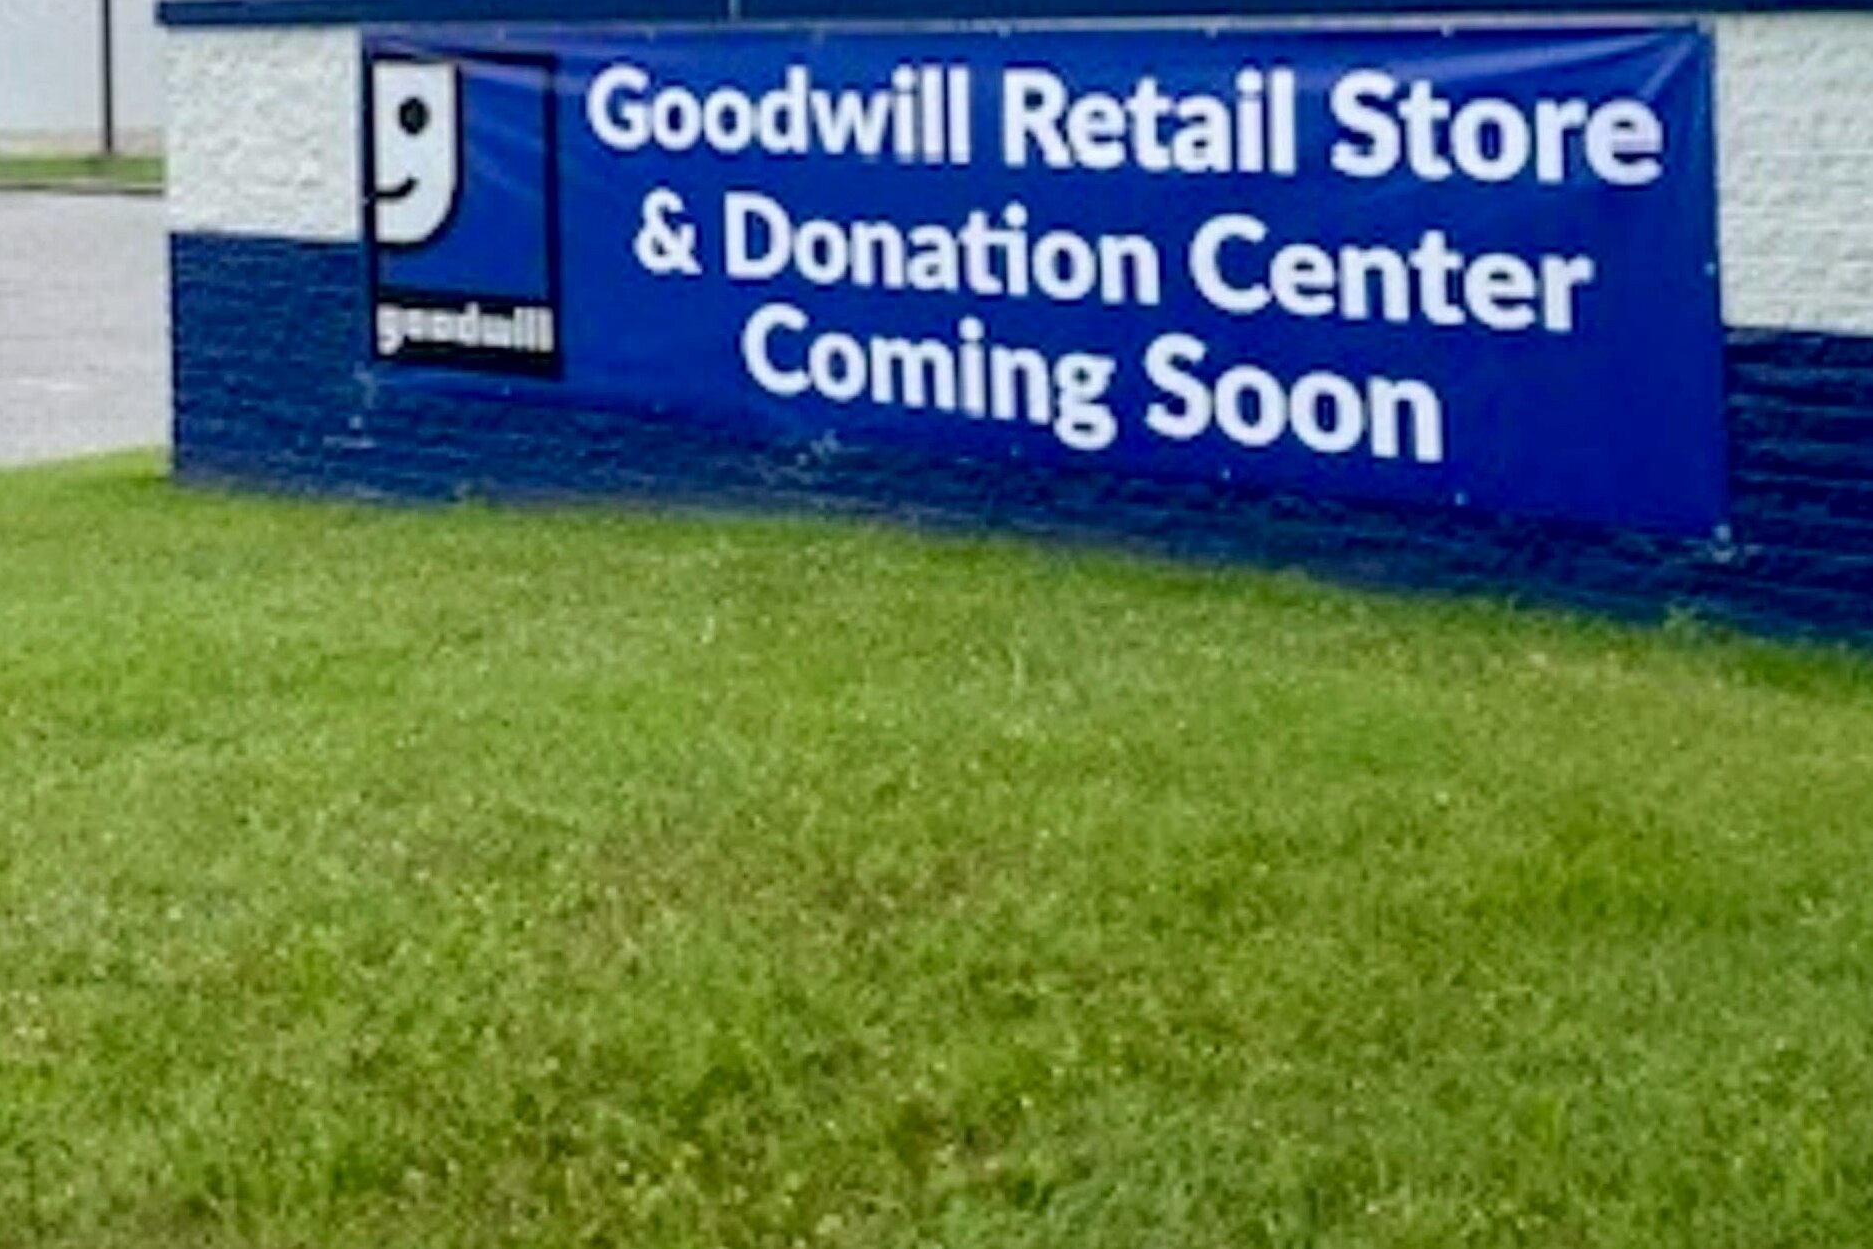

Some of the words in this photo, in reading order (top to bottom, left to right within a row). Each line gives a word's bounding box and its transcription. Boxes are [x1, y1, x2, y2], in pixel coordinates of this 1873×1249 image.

[586, 64, 972, 165] Goodwill
[1002, 67, 1297, 177] Retail
[1330, 69, 1663, 185] Store
[633, 187, 702, 275] &
[724, 191, 1160, 305] Donation
[1188, 213, 1594, 332] Center
[376, 301, 554, 356] goodwill
[742, 302, 1118, 451] Coming
[1144, 332, 1443, 463] Soon
